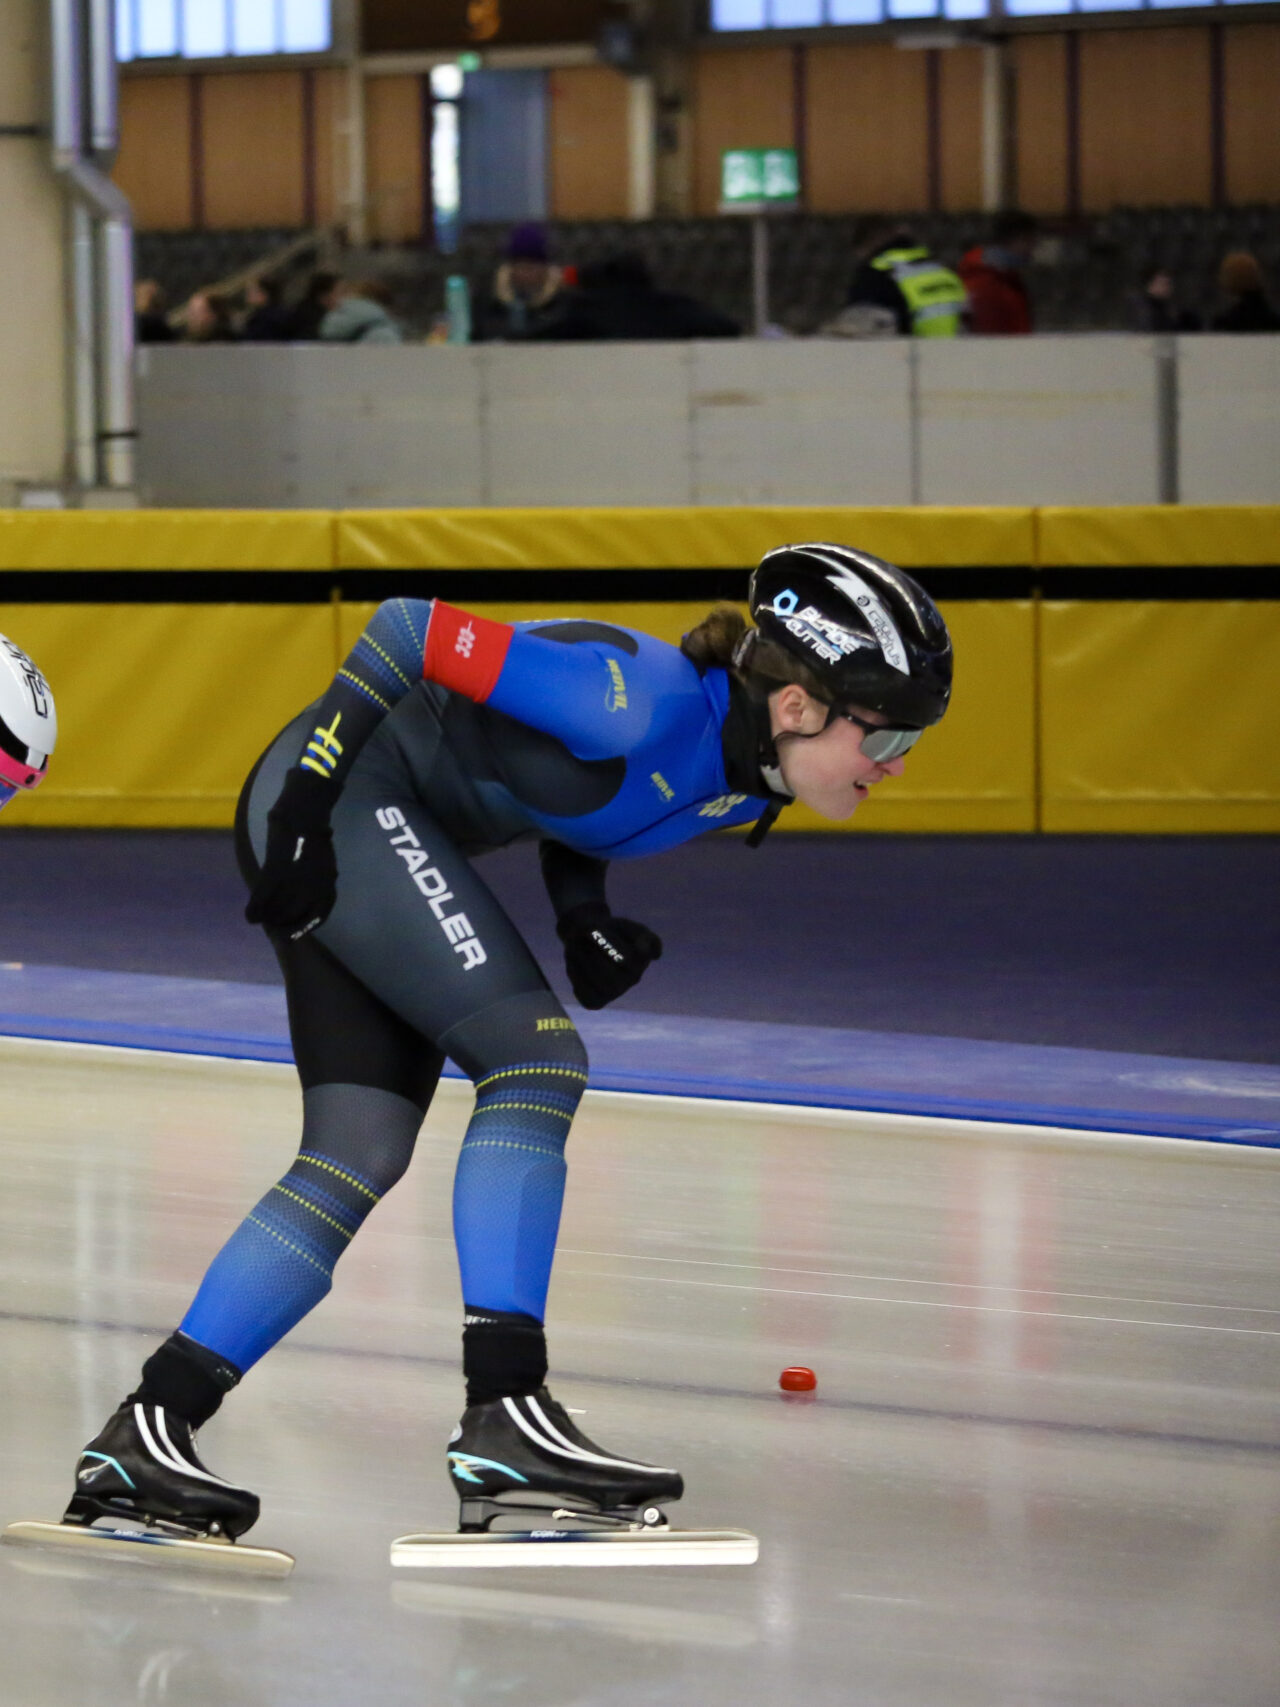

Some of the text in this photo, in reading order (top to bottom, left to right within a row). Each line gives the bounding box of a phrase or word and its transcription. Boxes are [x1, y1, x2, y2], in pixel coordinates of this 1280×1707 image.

[786, 618, 841, 665] CUTTER
[798, 606, 860, 655] BLADE
[375, 805, 488, 972] STADLER
